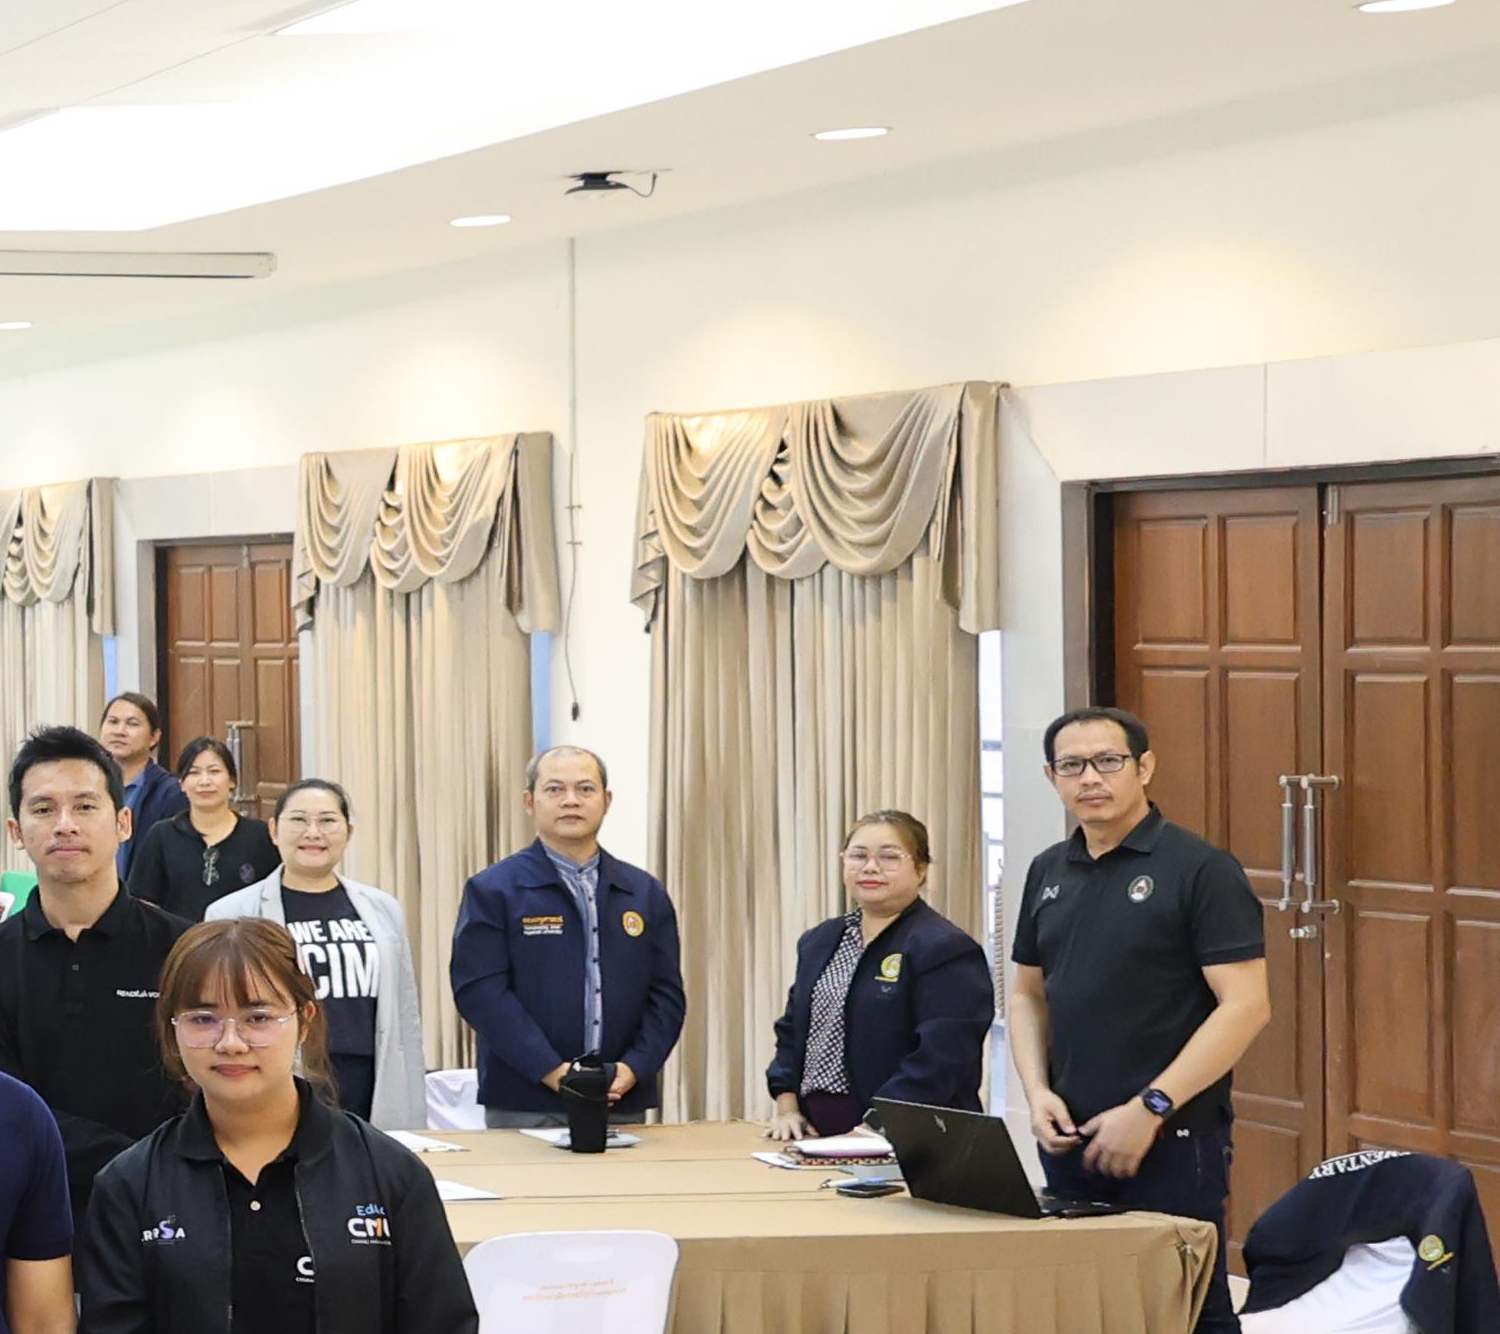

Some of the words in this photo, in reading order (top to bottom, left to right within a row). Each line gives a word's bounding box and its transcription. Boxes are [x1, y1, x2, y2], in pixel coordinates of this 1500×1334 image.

[287, 919, 328, 943] WE
[328, 918, 374, 942] ARE
[296, 942, 380, 1000] CIM
